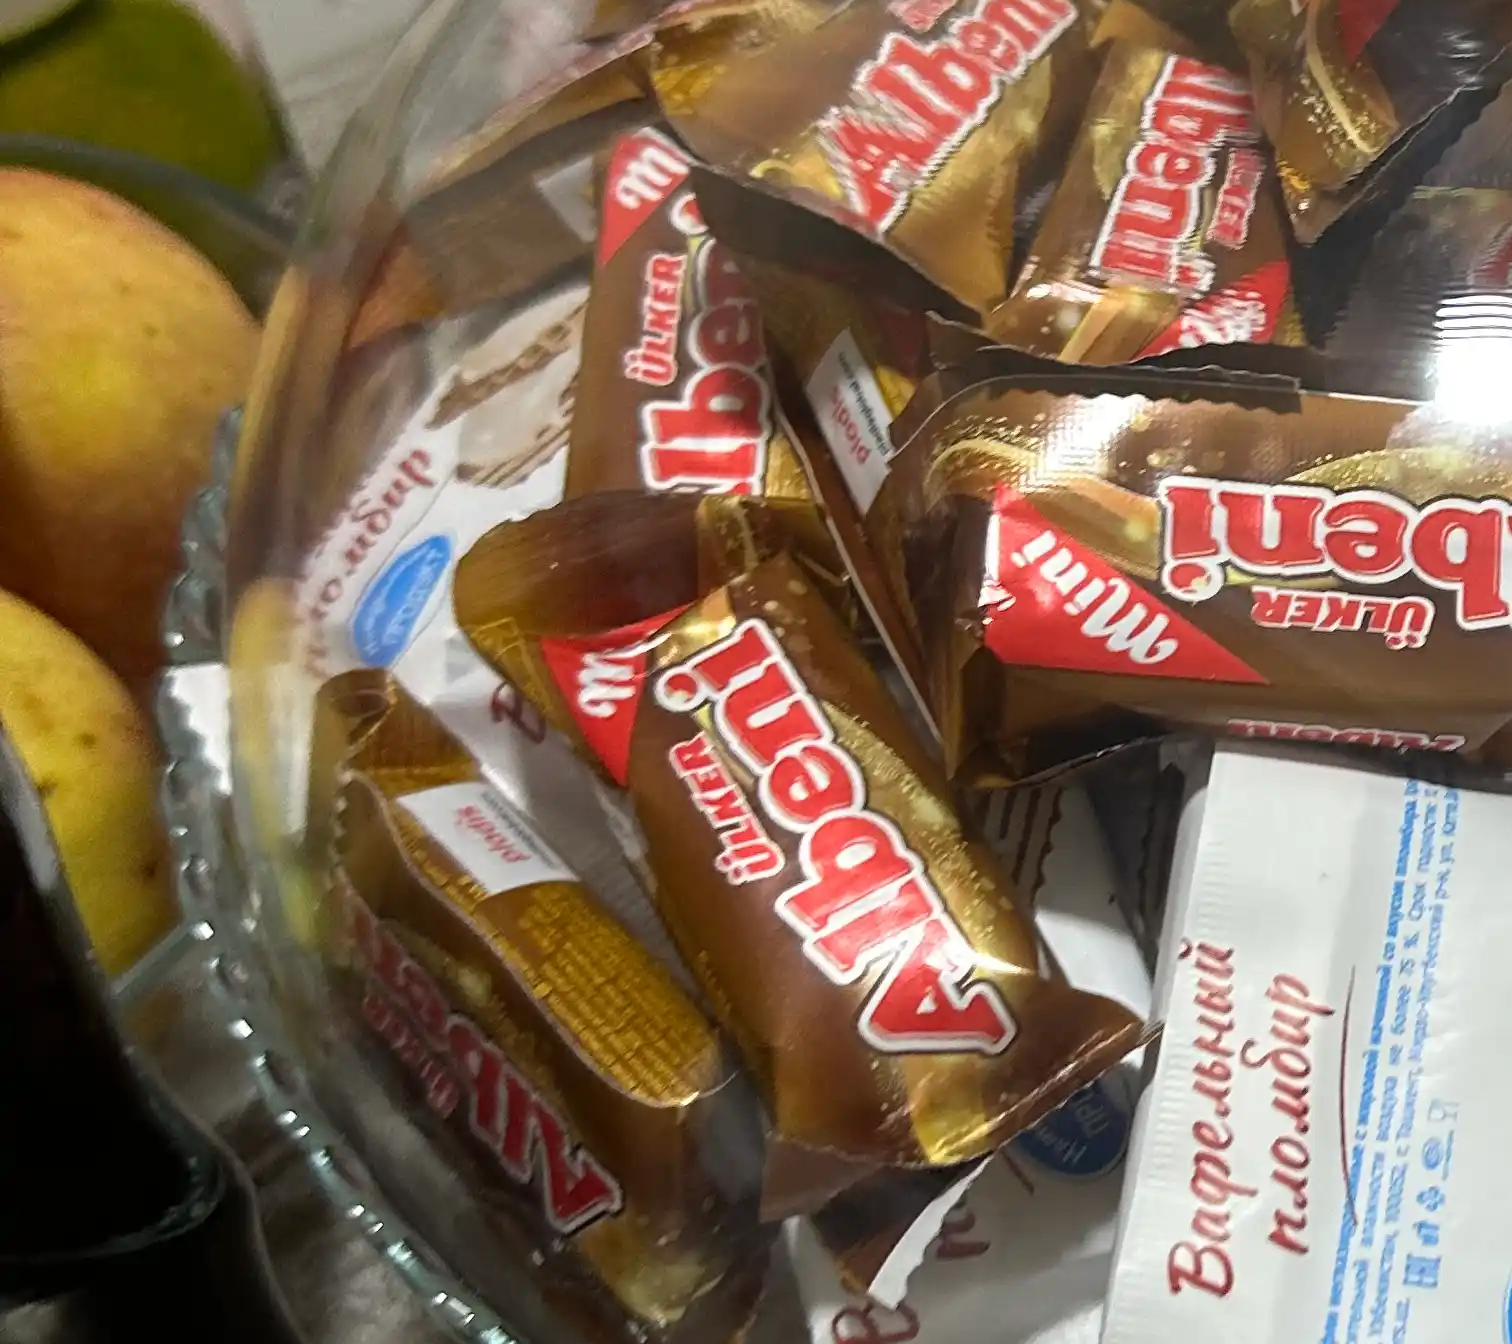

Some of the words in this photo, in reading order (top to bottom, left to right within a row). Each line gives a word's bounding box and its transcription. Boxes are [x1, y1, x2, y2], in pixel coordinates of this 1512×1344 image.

[625, 253, 687, 385] ÜLKER
[1012, 529, 1178, 665] Mini
[1251, 585, 1435, 650] ÜLKER
[656, 617, 1018, 1055] Albeni
[669, 733, 785, 887] ÜLKER
[1166, 937, 1258, 1301] Вафельный
[1240, 972, 1336, 1256] пломбир
